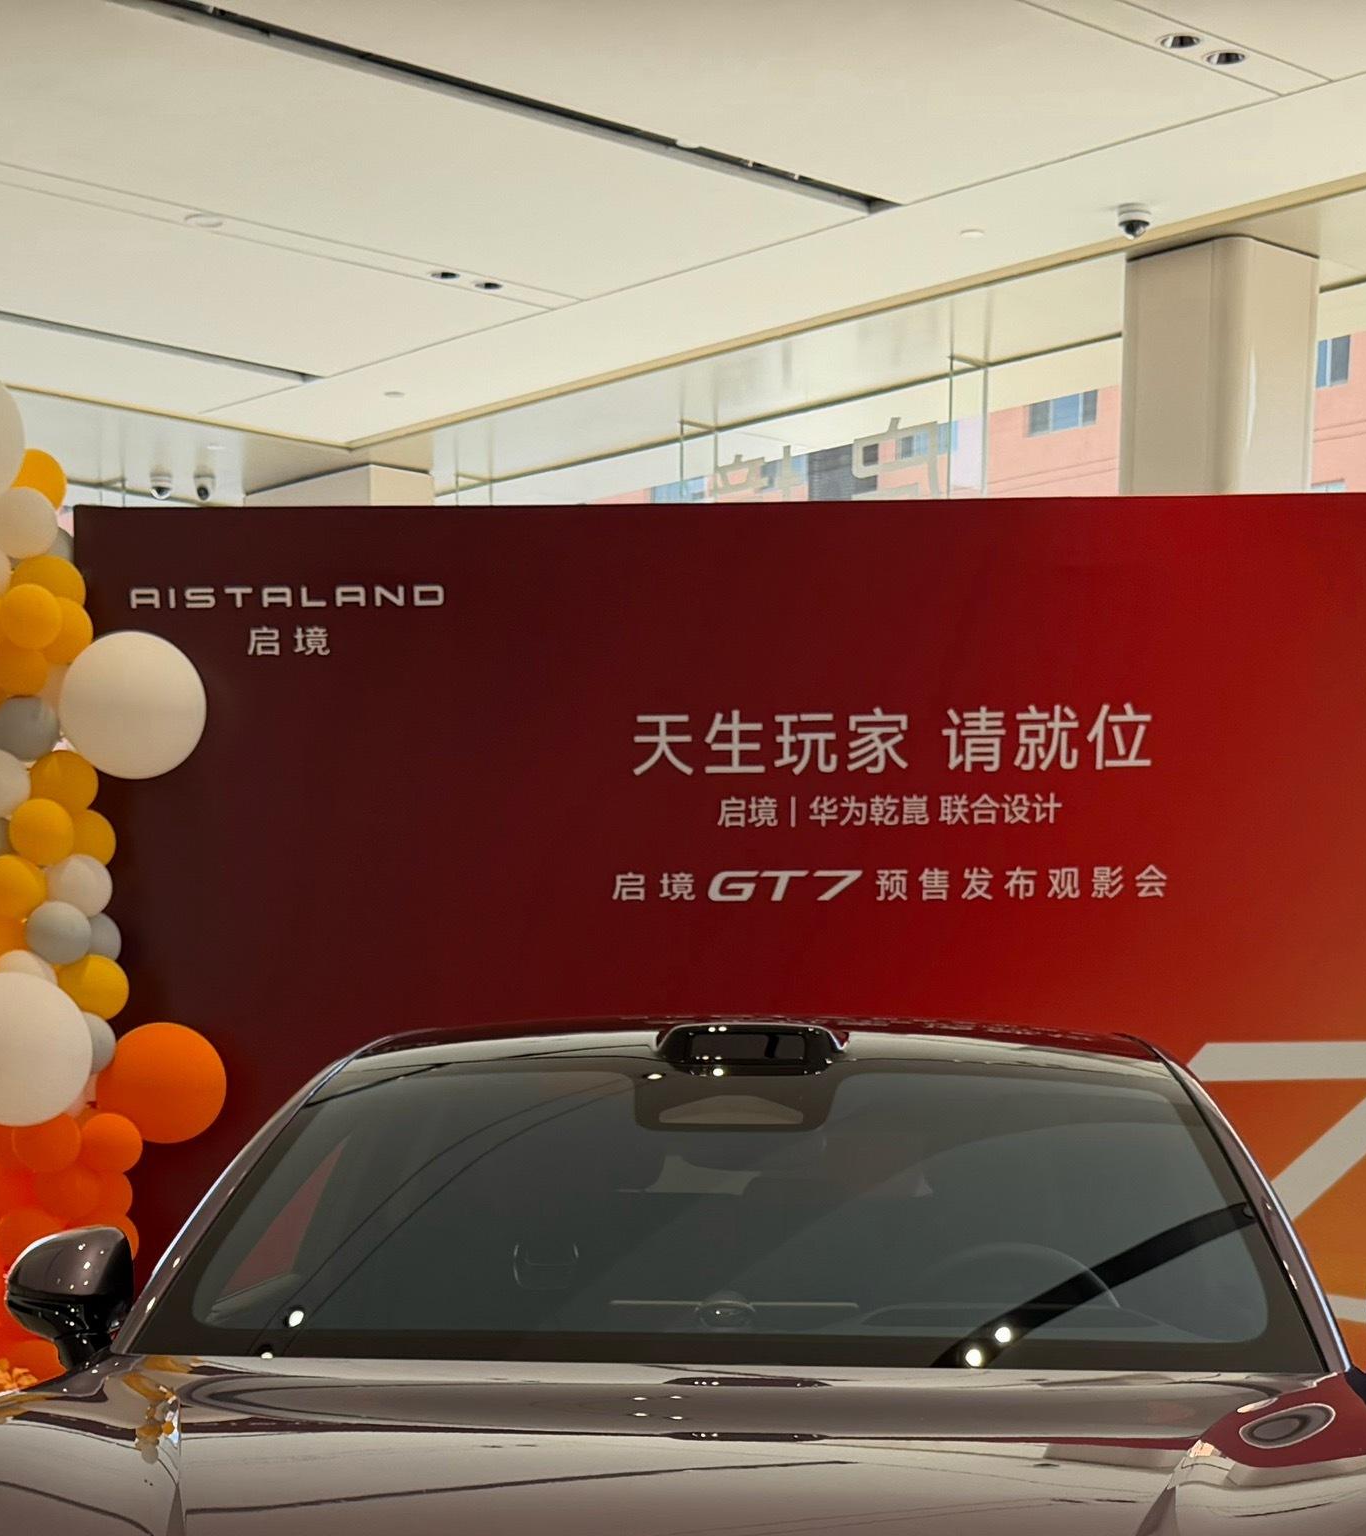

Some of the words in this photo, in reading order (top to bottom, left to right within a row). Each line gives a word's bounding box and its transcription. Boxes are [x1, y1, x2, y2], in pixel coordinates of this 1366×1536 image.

[129, 585, 445, 609] AISTALAND
[247, 626, 331, 656] 启境
[632, 708, 909, 776] 天生玩家
[941, 702, 1154, 774] 请就位
[717, 796, 778, 828] 启境
[809, 794, 930, 827] 华为乾崑
[938, 793, 1063, 826] 联合设计
